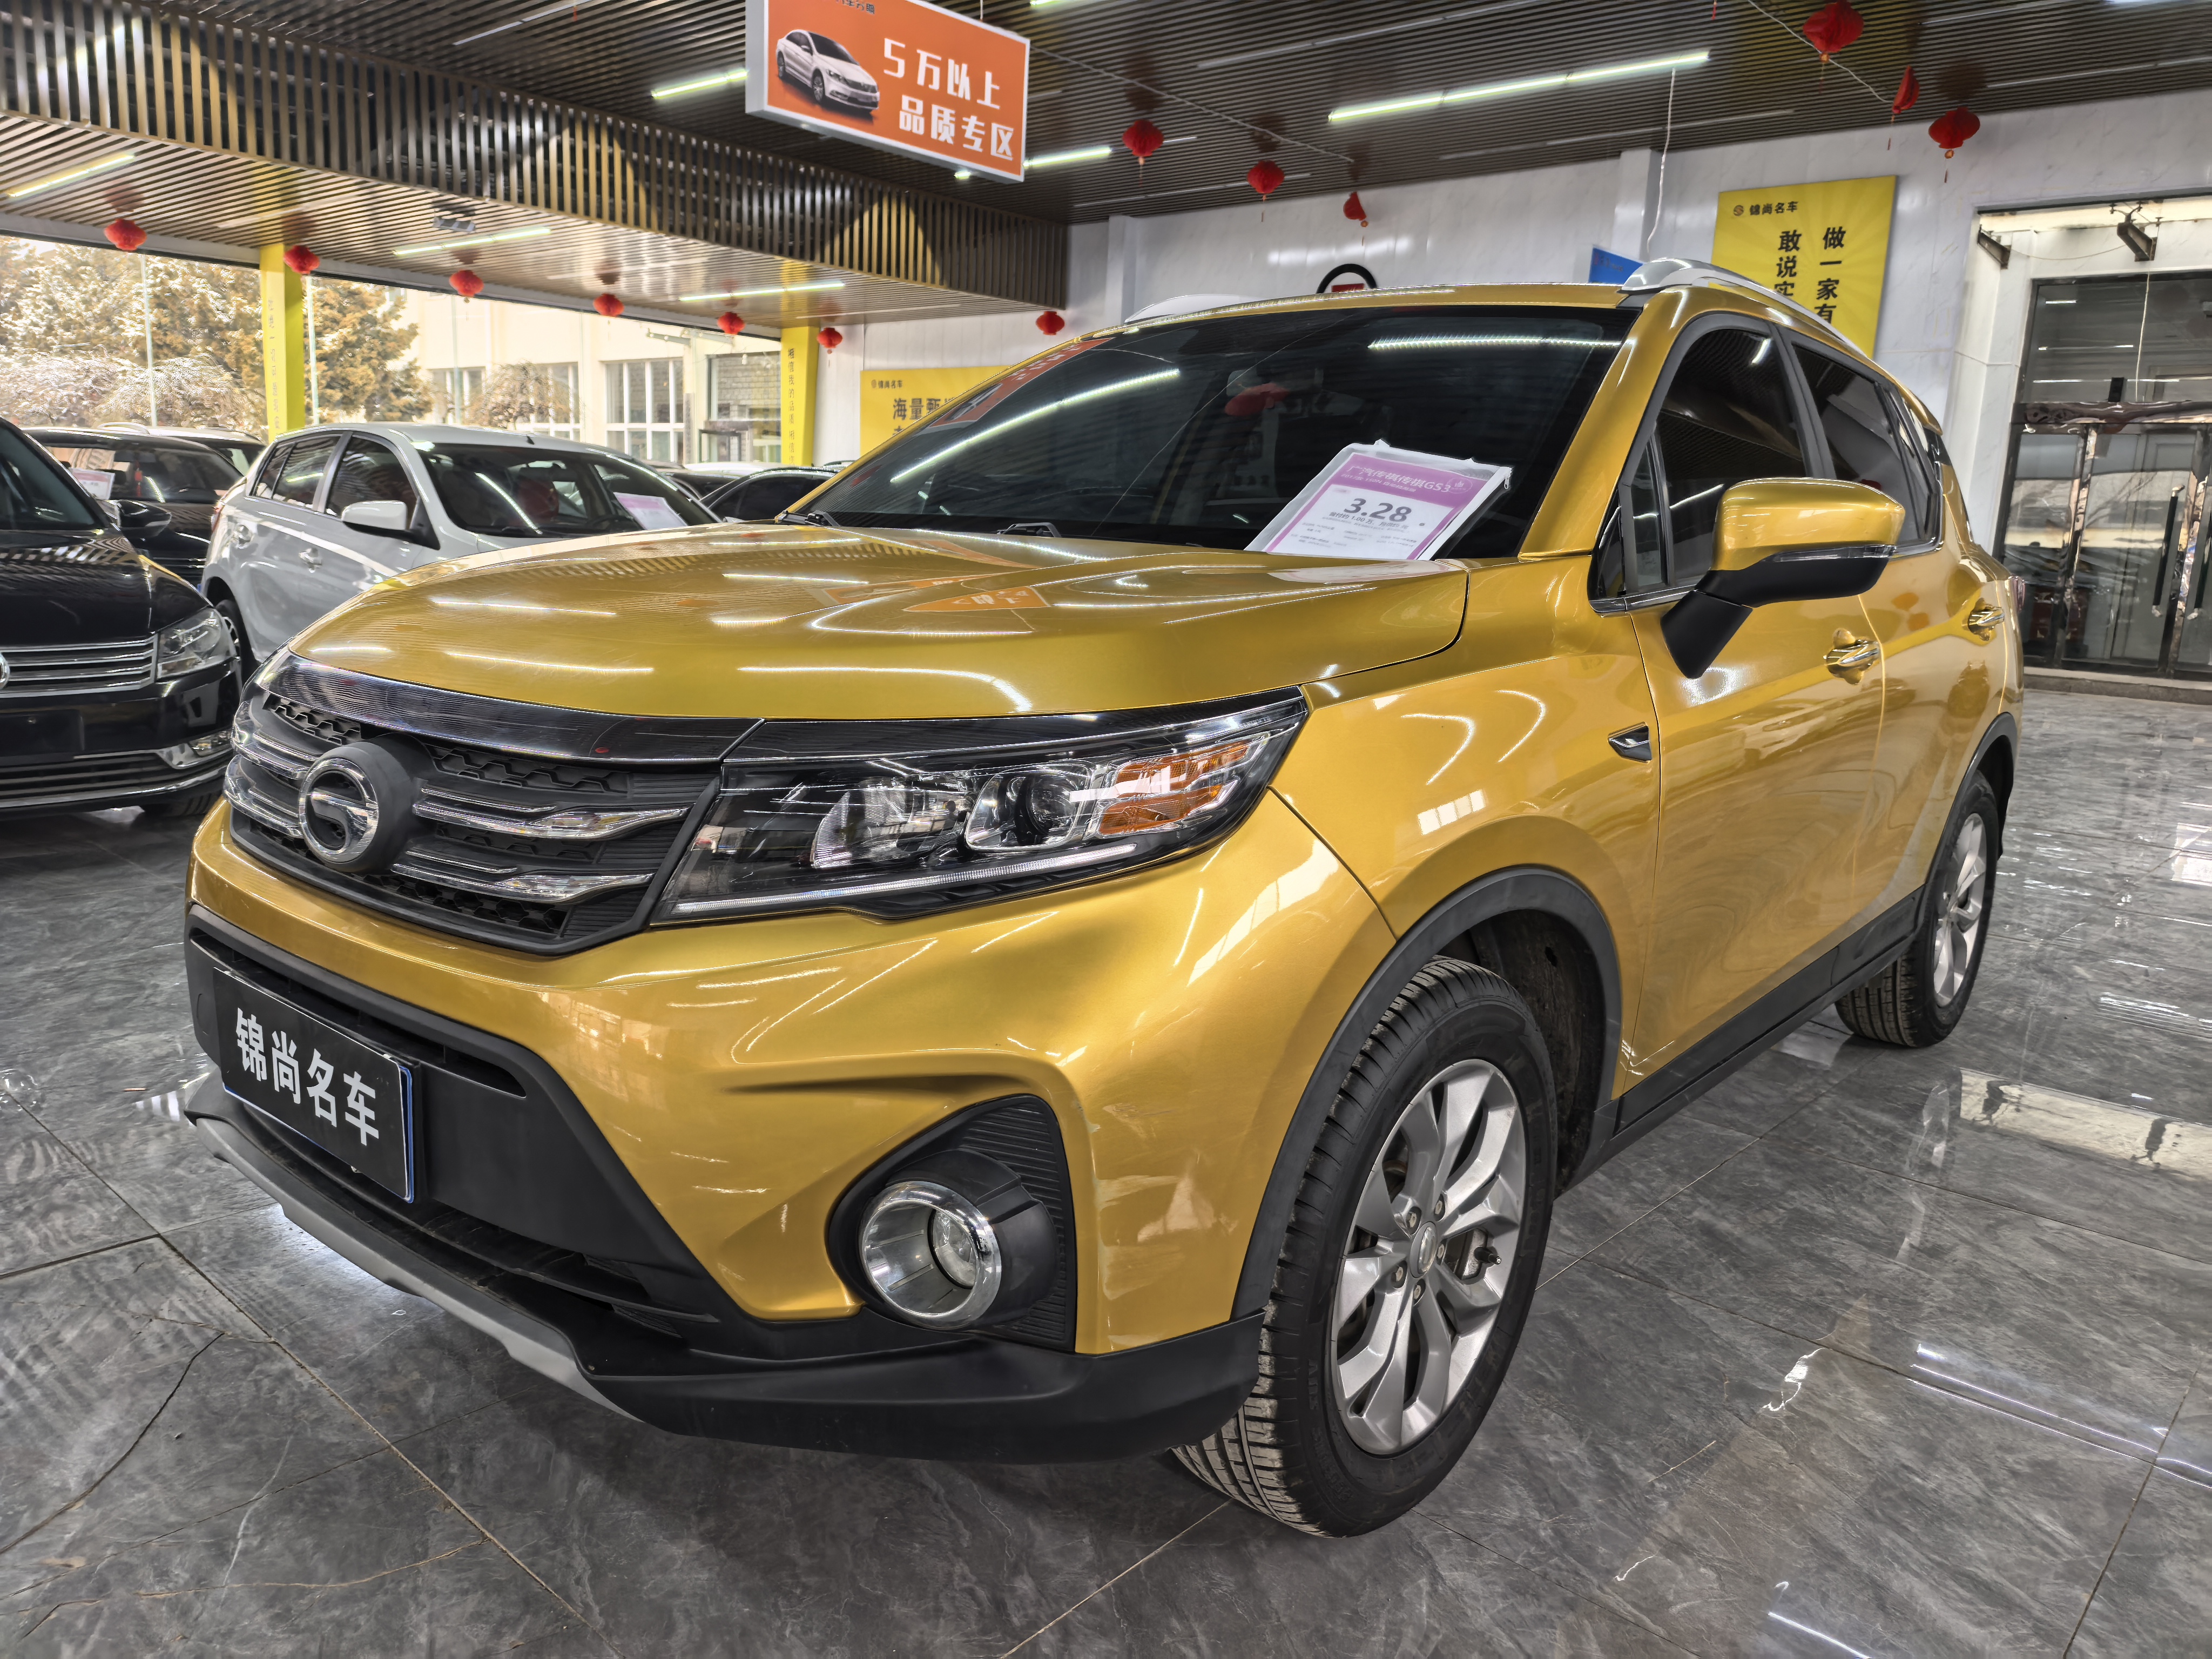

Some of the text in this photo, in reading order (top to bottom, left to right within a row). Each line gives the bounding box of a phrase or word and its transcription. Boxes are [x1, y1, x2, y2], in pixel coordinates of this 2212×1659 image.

[884, 38, 1000, 110] 5万以上
[899, 95, 1014, 161] 品质专区
[1750, 201, 1798, 215] 锦尚名车
[1773, 229, 1802, 296] 敢说实
[1814, 226, 1846, 324] 做一家有
[1343, 498, 1412, 522] 3.28
[1347, 466, 1452, 493] 广汽传祺传祺GS3
[235, 1007, 380, 1147] 锦尚名车
